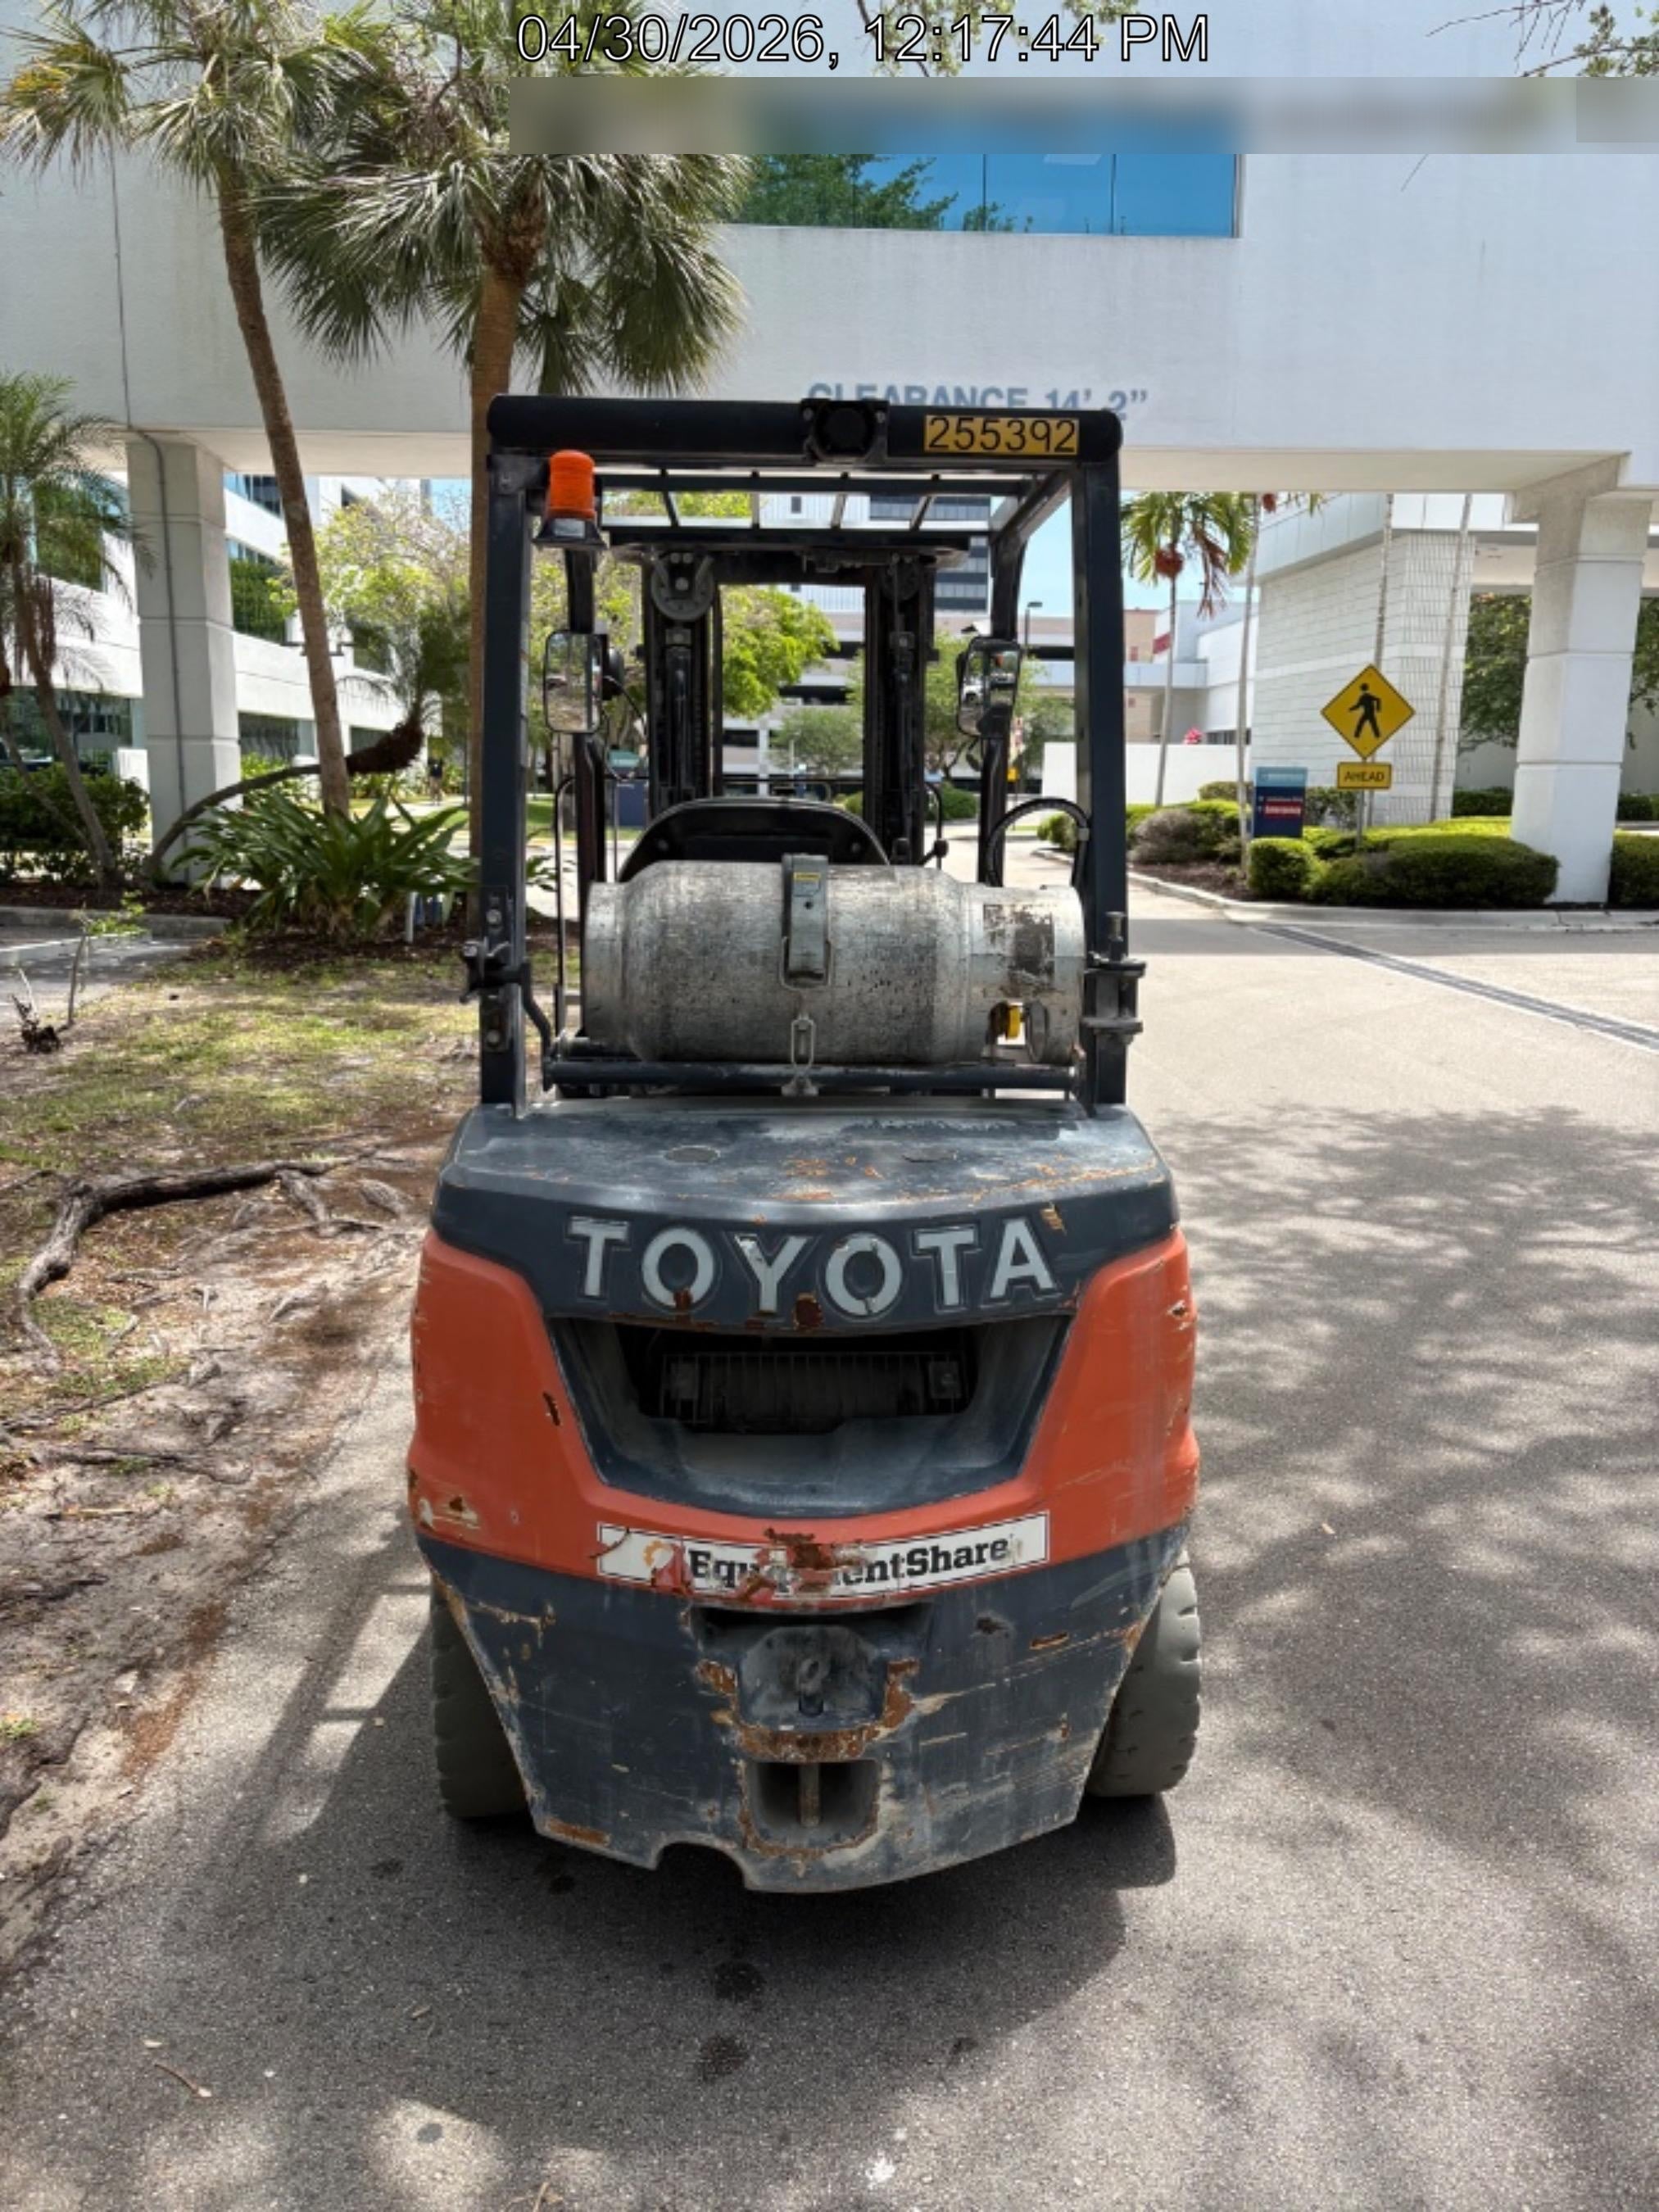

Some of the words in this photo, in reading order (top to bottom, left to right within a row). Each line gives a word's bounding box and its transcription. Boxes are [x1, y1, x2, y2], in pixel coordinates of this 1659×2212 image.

[927, 417, 1077, 453] 255392
[1344, 771, 1385, 782] AHEAD
[567, 1217, 1054, 1317] TOYOTA
